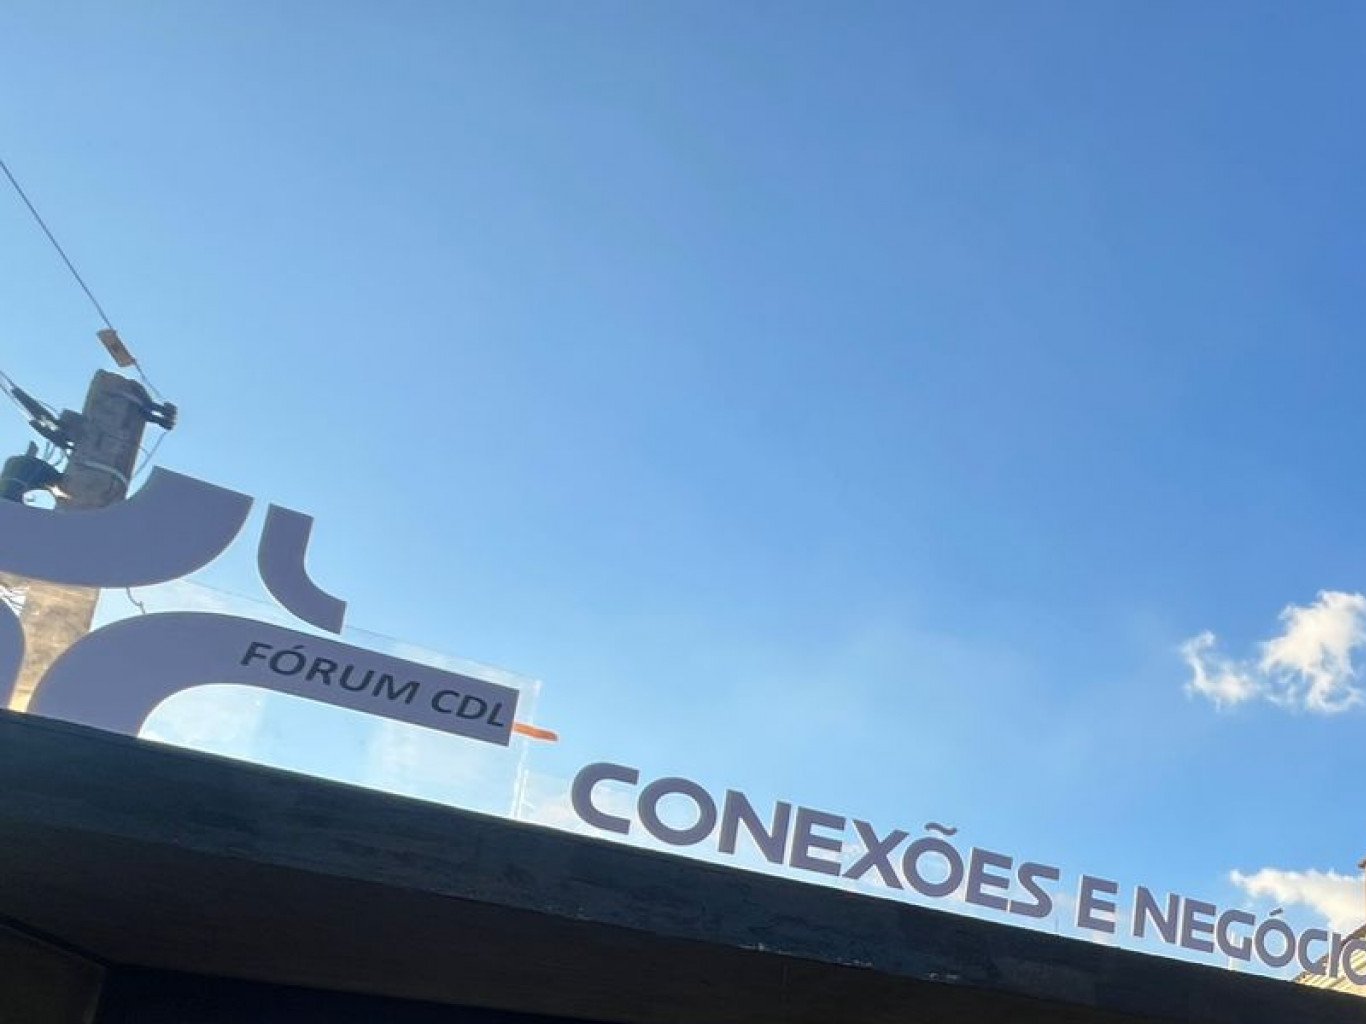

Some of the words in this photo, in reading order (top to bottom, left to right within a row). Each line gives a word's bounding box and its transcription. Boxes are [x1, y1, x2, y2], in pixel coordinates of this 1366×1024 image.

[240, 641, 420, 704] FÓRUM
[431, 689, 505, 727] CDL
[571, 762, 1060, 918] CONEXÕES
[1077, 875, 1118, 934] E
